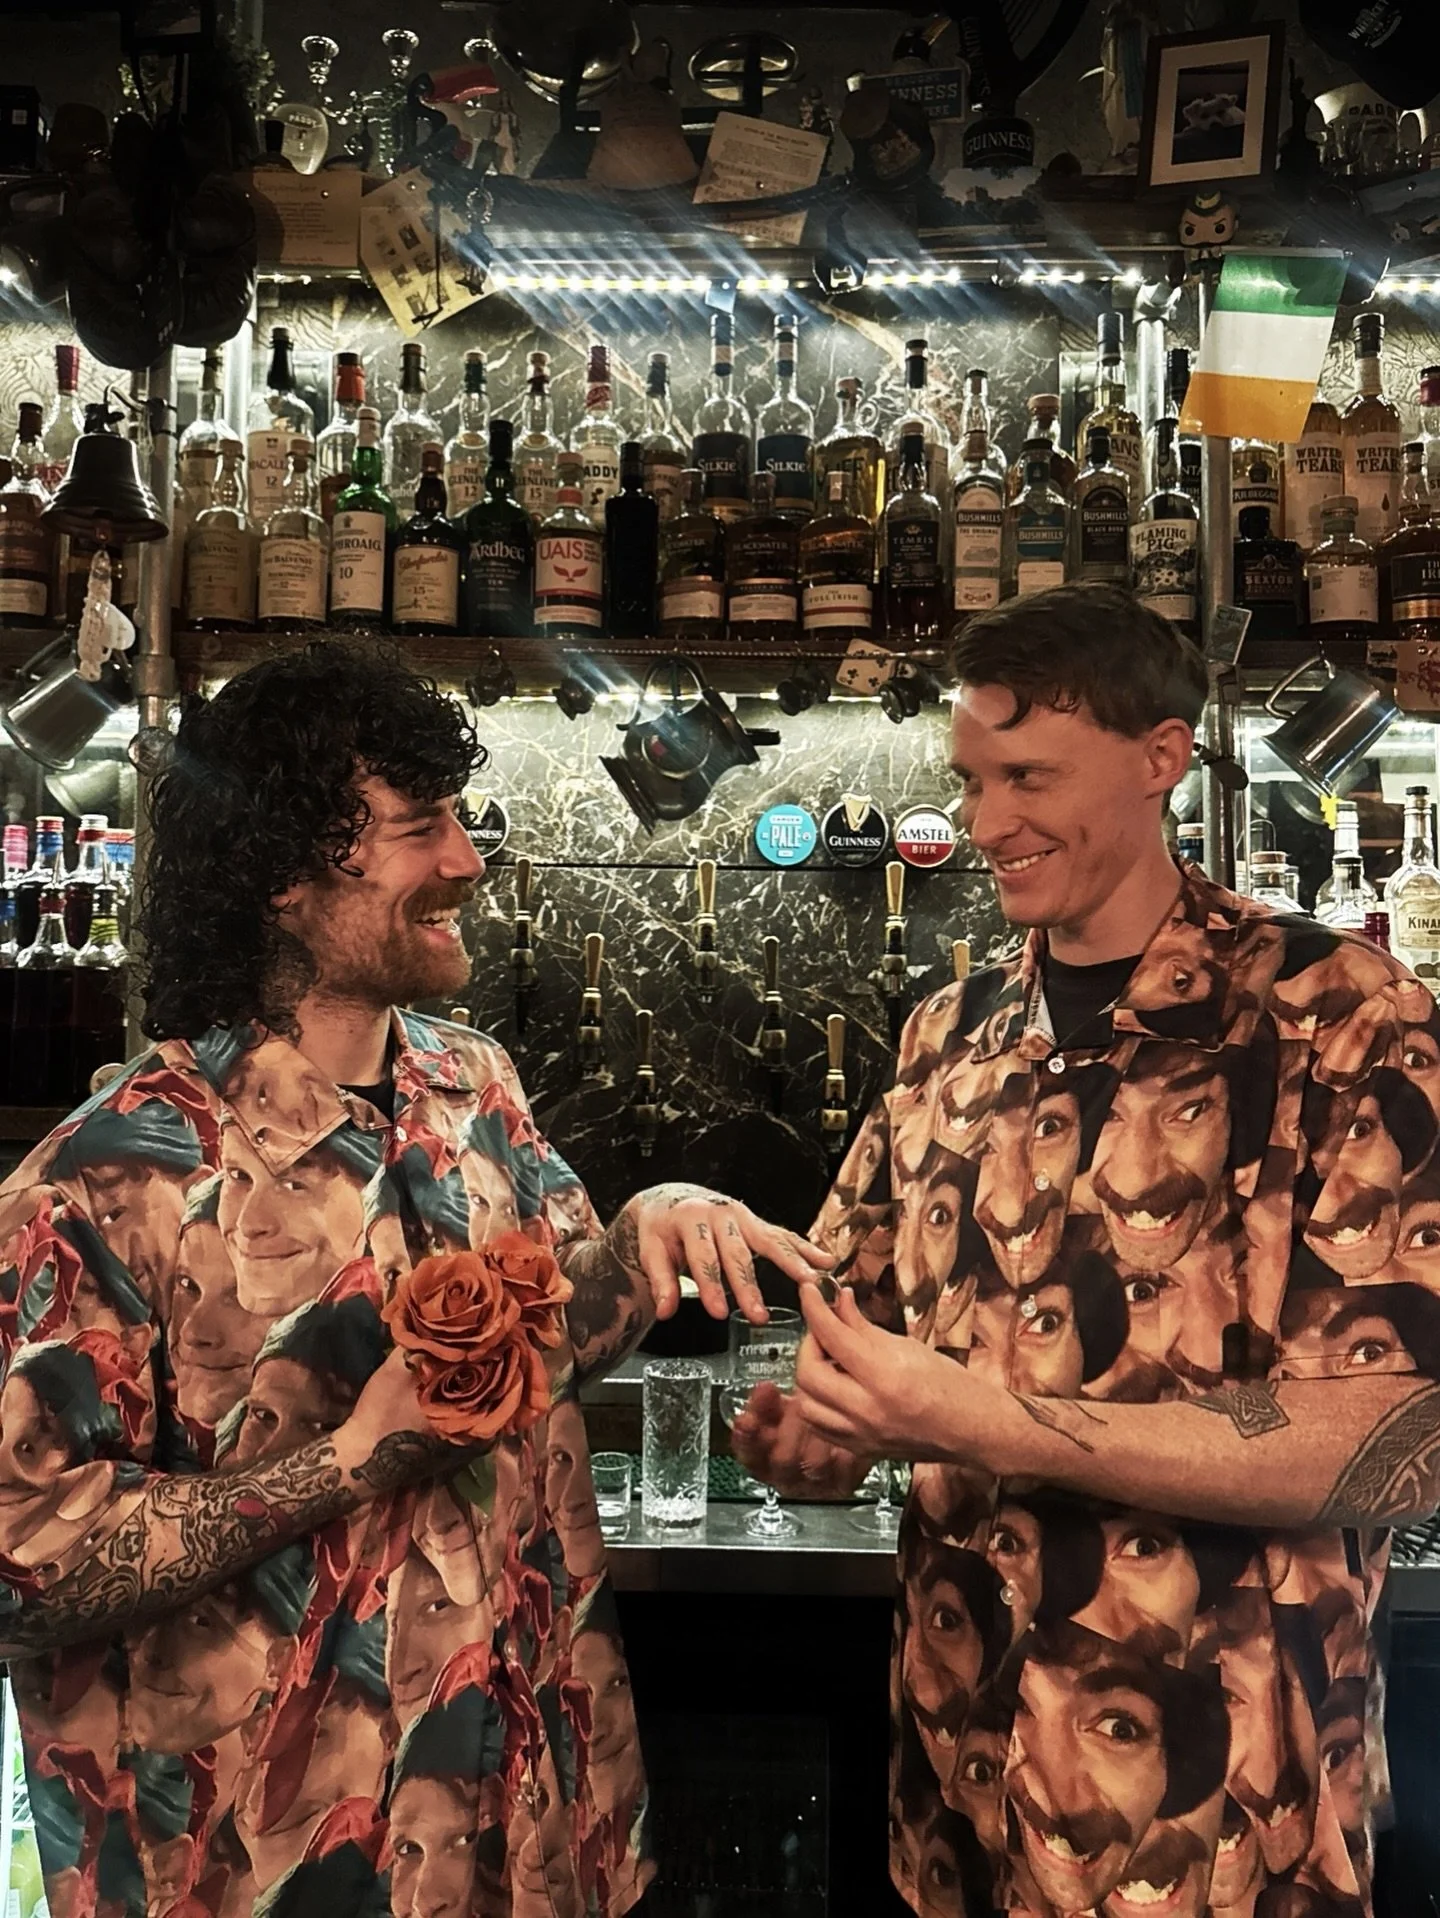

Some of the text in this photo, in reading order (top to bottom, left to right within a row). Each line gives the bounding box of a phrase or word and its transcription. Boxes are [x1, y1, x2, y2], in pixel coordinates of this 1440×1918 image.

[965, 131, 1031, 155] GUINNESS
[765, 458, 806, 472] SILKIE
[1356, 458, 1400, 473] TEAR
[266, 475, 278, 486] 12
[464, 486, 477, 497] 12
[530, 488, 542, 498] 15
[957, 513, 1001, 523] BUSHMILLS
[1083, 511, 1127, 521] BUSHMILLS
[1019, 531, 1064, 541] BUSHMILLS
[1136, 526, 1187, 545] FLAMING
[540, 541, 584, 560] UAIS
[1147, 538, 1174, 552] PIG
[340, 567, 354, 579] 10
[771, 825, 802, 848] PALE
[898, 828, 951, 841] AMSTEL
[829, 835, 882, 847] GUINNESS
[911, 844, 937, 854] BIER
